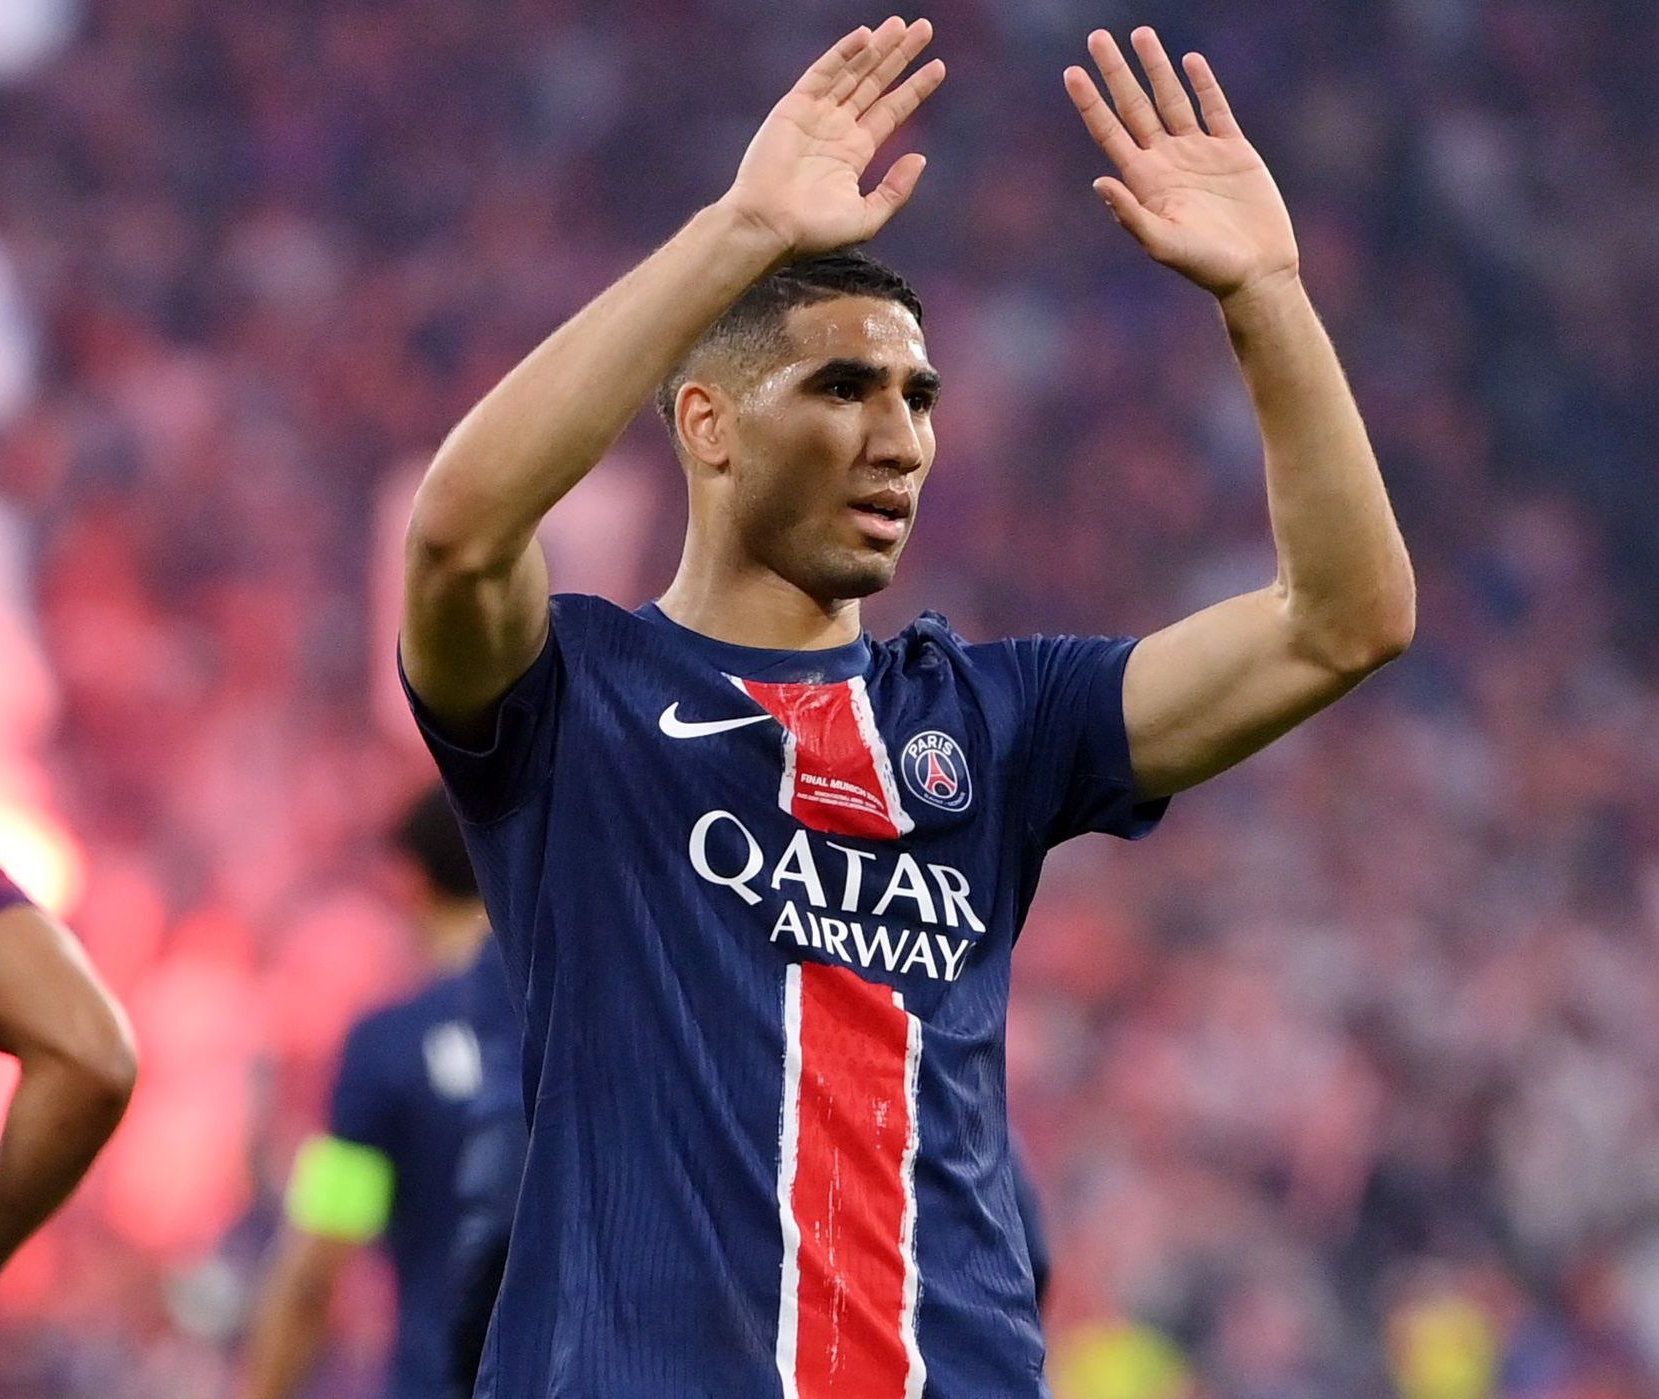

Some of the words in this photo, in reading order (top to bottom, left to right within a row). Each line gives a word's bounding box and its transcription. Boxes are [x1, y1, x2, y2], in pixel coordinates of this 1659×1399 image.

[908, 735, 954, 759] PARIS
[801, 773, 829, 788] FINAL
[688, 809, 987, 933] QATAR
[769, 900, 976, 982] AIRWAY
